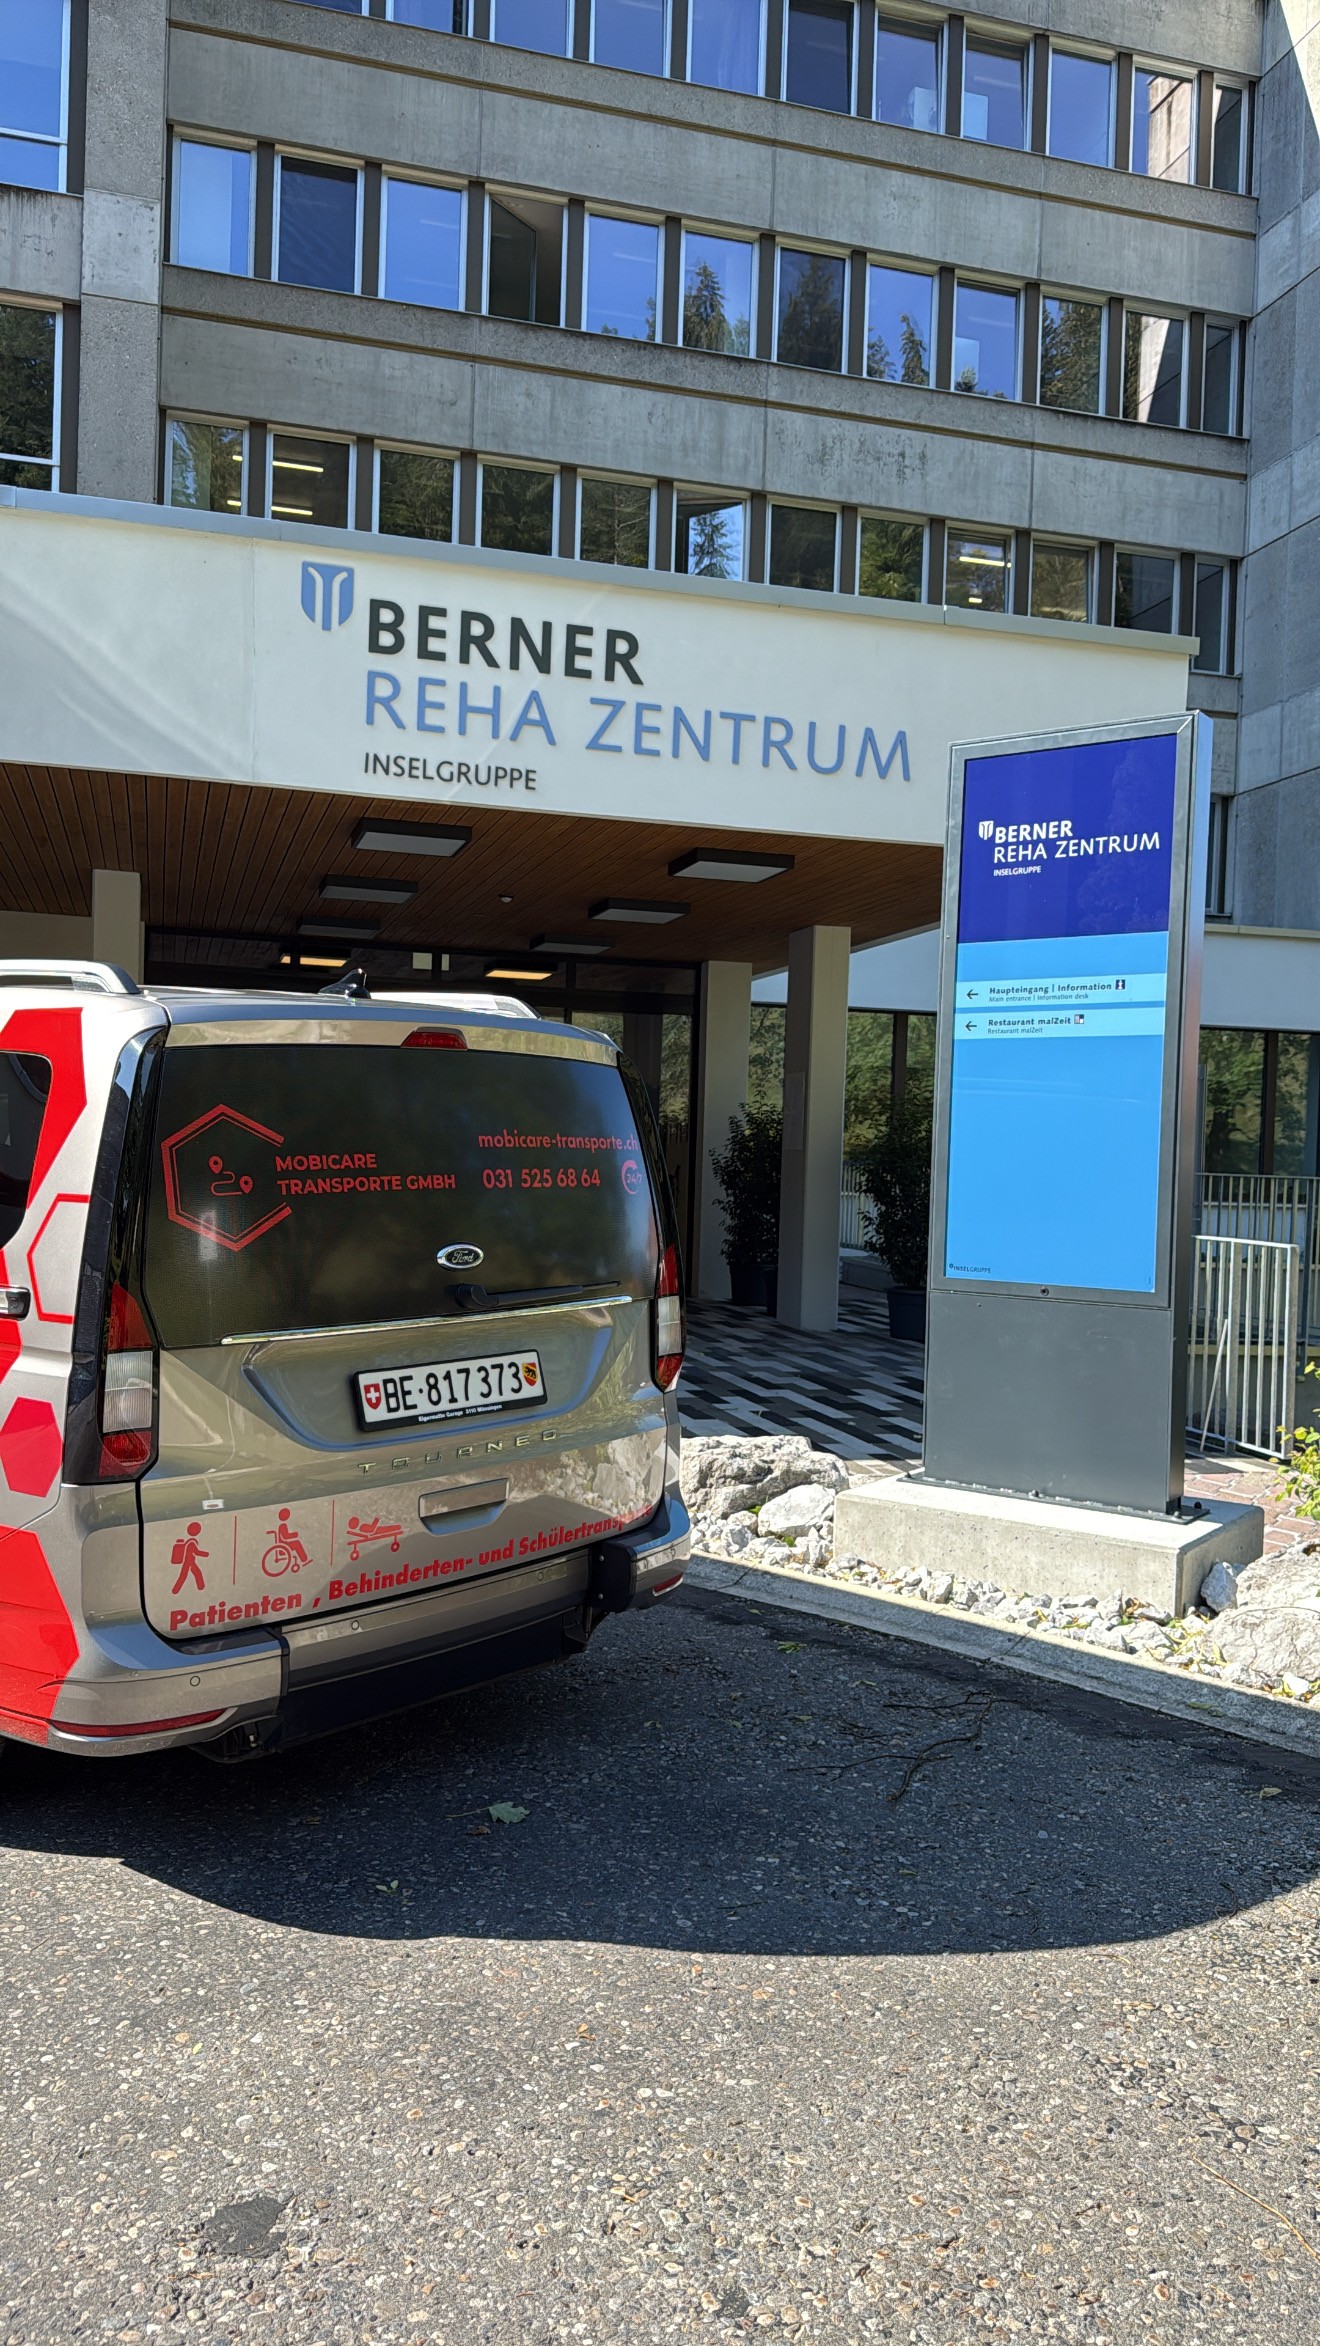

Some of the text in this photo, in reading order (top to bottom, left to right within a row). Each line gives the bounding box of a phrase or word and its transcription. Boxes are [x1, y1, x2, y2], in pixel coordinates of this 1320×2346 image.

[368, 598, 645, 686] BERNER
[364, 669, 912, 783] REHA ZENTRUM
[363, 751, 538, 792] INSELGRUPPE
[994, 820, 1074, 844] BERNER
[993, 831, 1161, 864] REHA ZENTRUM
[993, 865, 1042, 877] INSELGRUPPE
[989, 985, 1050, 995] Haupteingang
[1057, 982, 1112, 993] Information
[987, 1027, 1020, 1035] Restaurant
[988, 1017, 1035, 1027] Restaurant
[478, 1128, 638, 1153] mobicare-transporte.ch
[275, 1153, 378, 1172] MOBICARE
[276, 1174, 456, 1196] TRANSPORTE GMBH
[482, 1168, 601, 1189] 031 525 68 64
[625, 1173, 643, 1184] 24/7
[358, 1429, 557, 1474] TOURNEO
[170, 1593, 302, 1631] Patienten
[329, 1562, 473, 1600] Behinderten-
[479, 1538, 515, 1566] und
